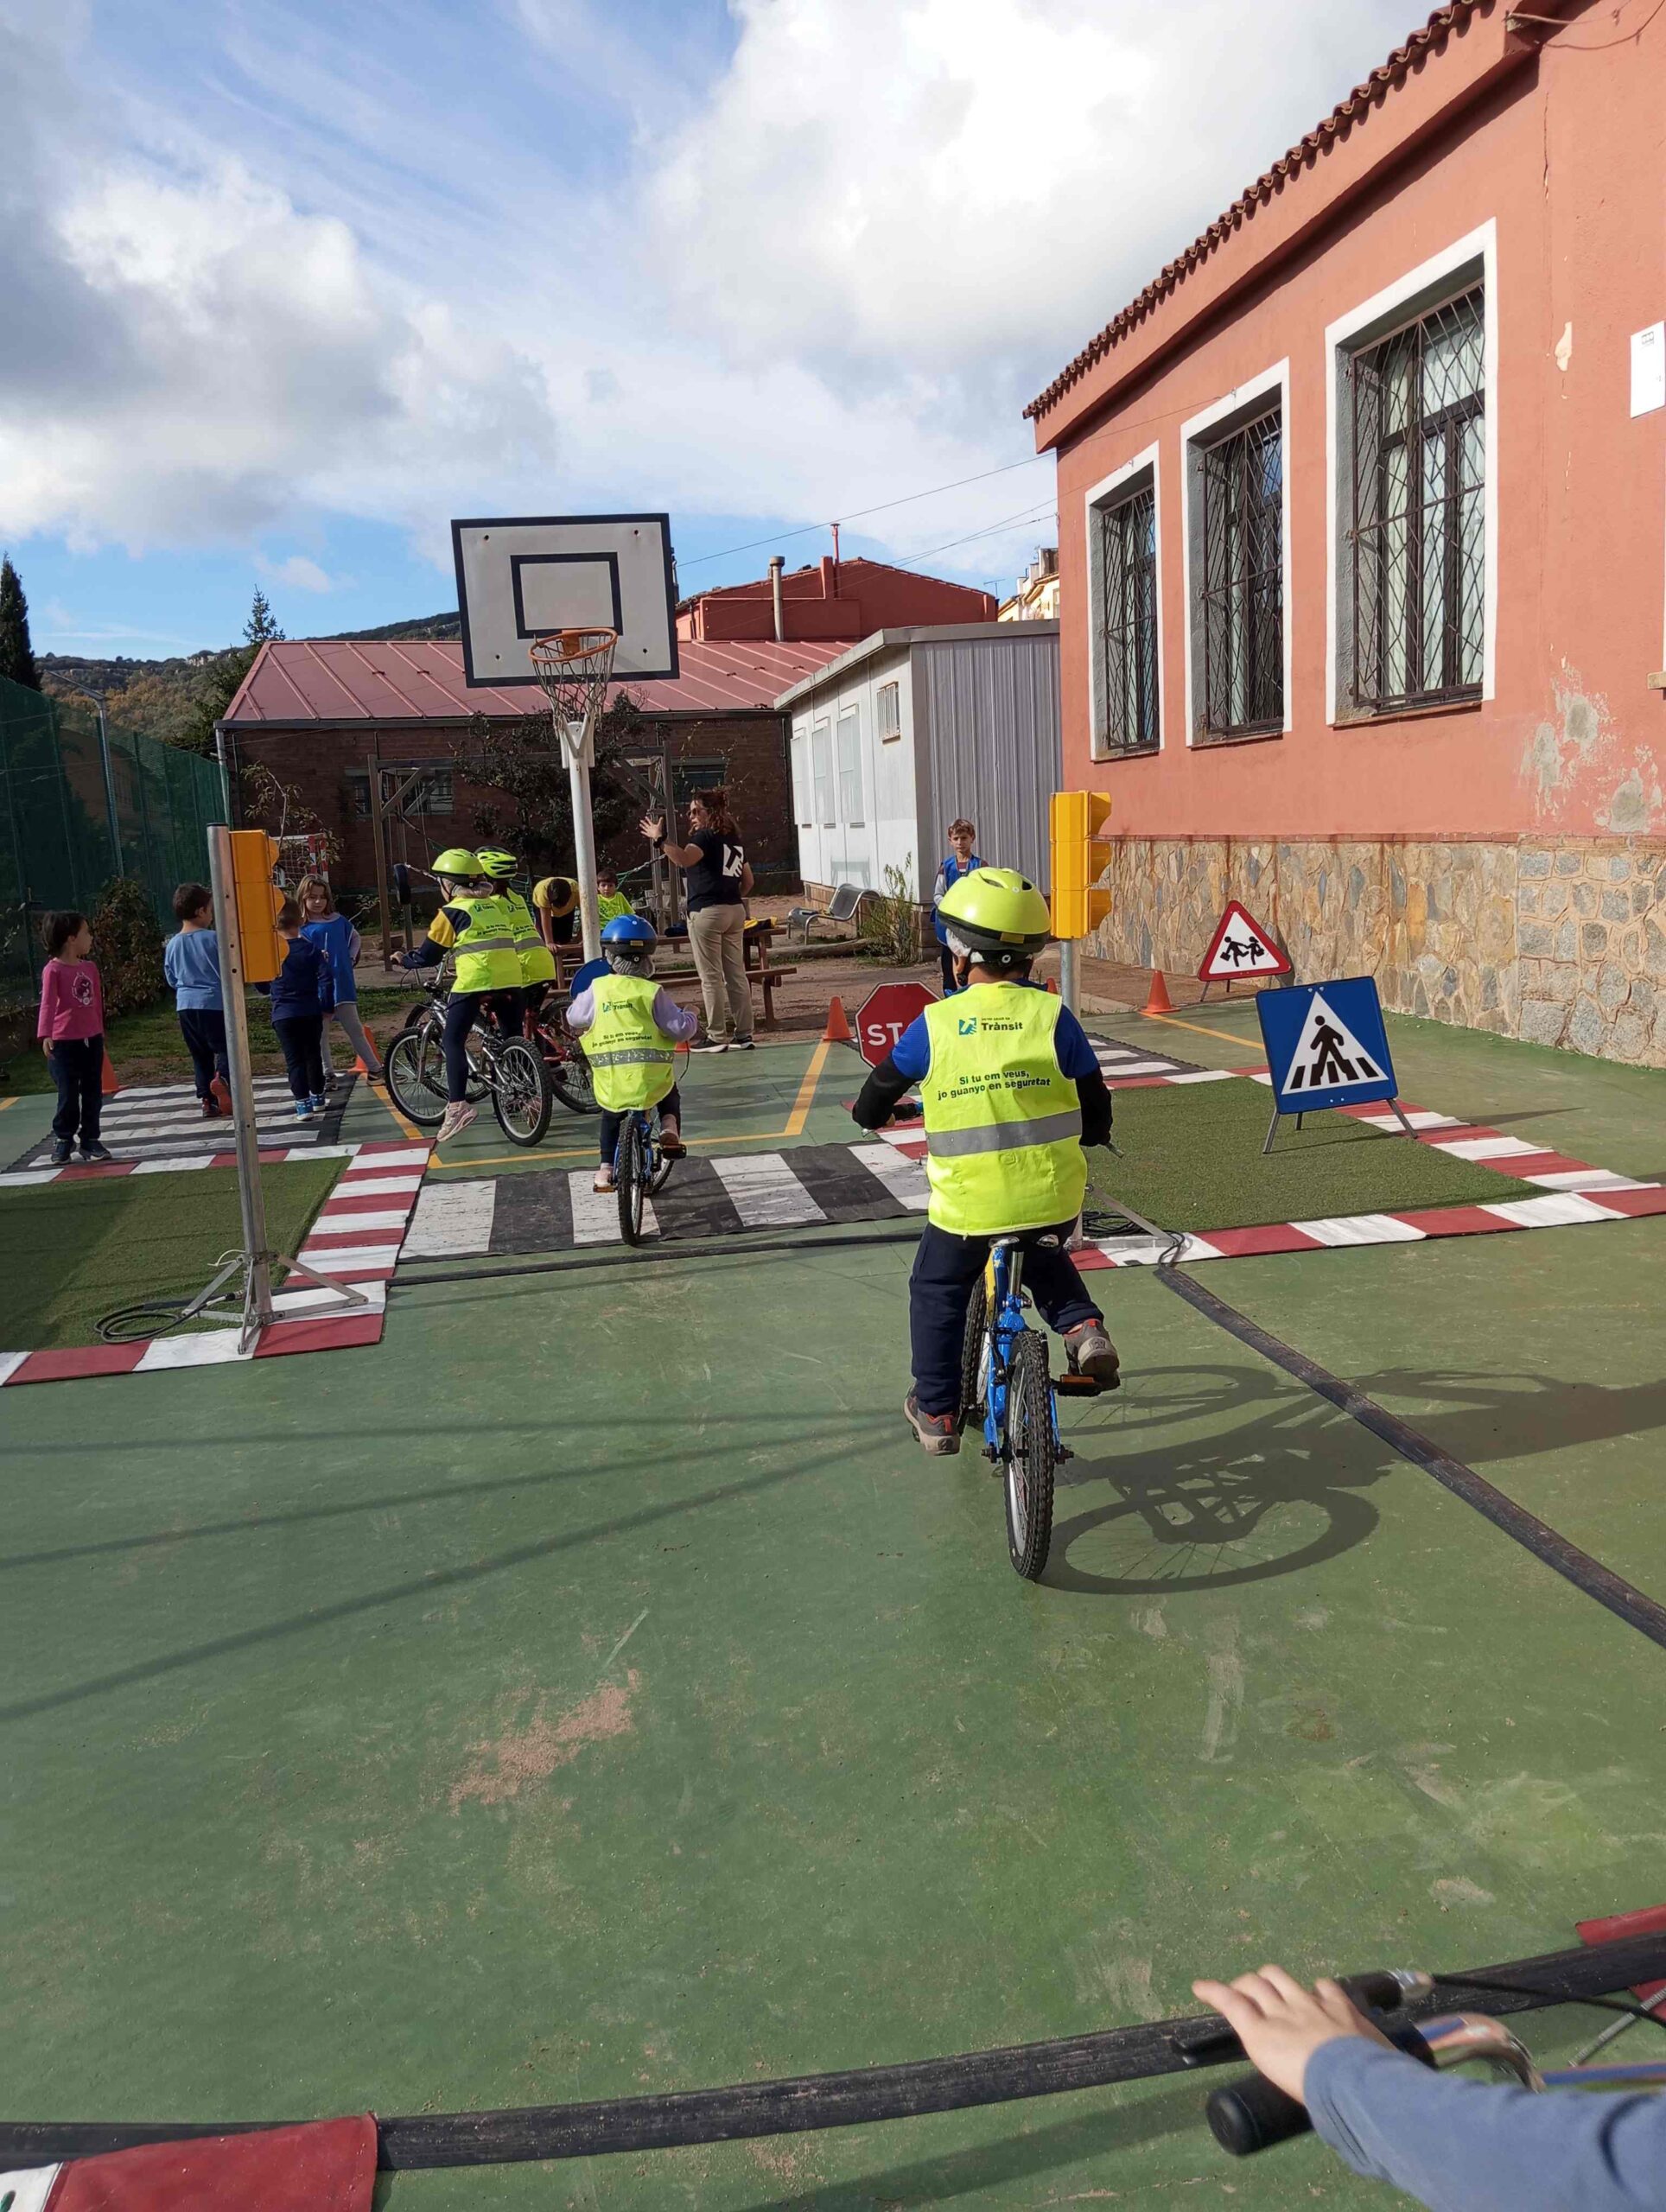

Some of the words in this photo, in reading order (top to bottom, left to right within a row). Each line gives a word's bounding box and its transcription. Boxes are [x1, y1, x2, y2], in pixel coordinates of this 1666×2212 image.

[867, 1022, 904, 1046] ST
[981, 1021, 1023, 1031] Trànsit
[959, 1077, 969, 1085] Si
[984, 1072, 1001, 1081] em
[1003, 1070, 1030, 1078] veus,
[938, 1090, 948, 1101] jo
[951, 1084, 986, 1098] guanyo
[989, 1082, 1002, 1090] en
[1004, 1077, 1051, 1089] seguretat
